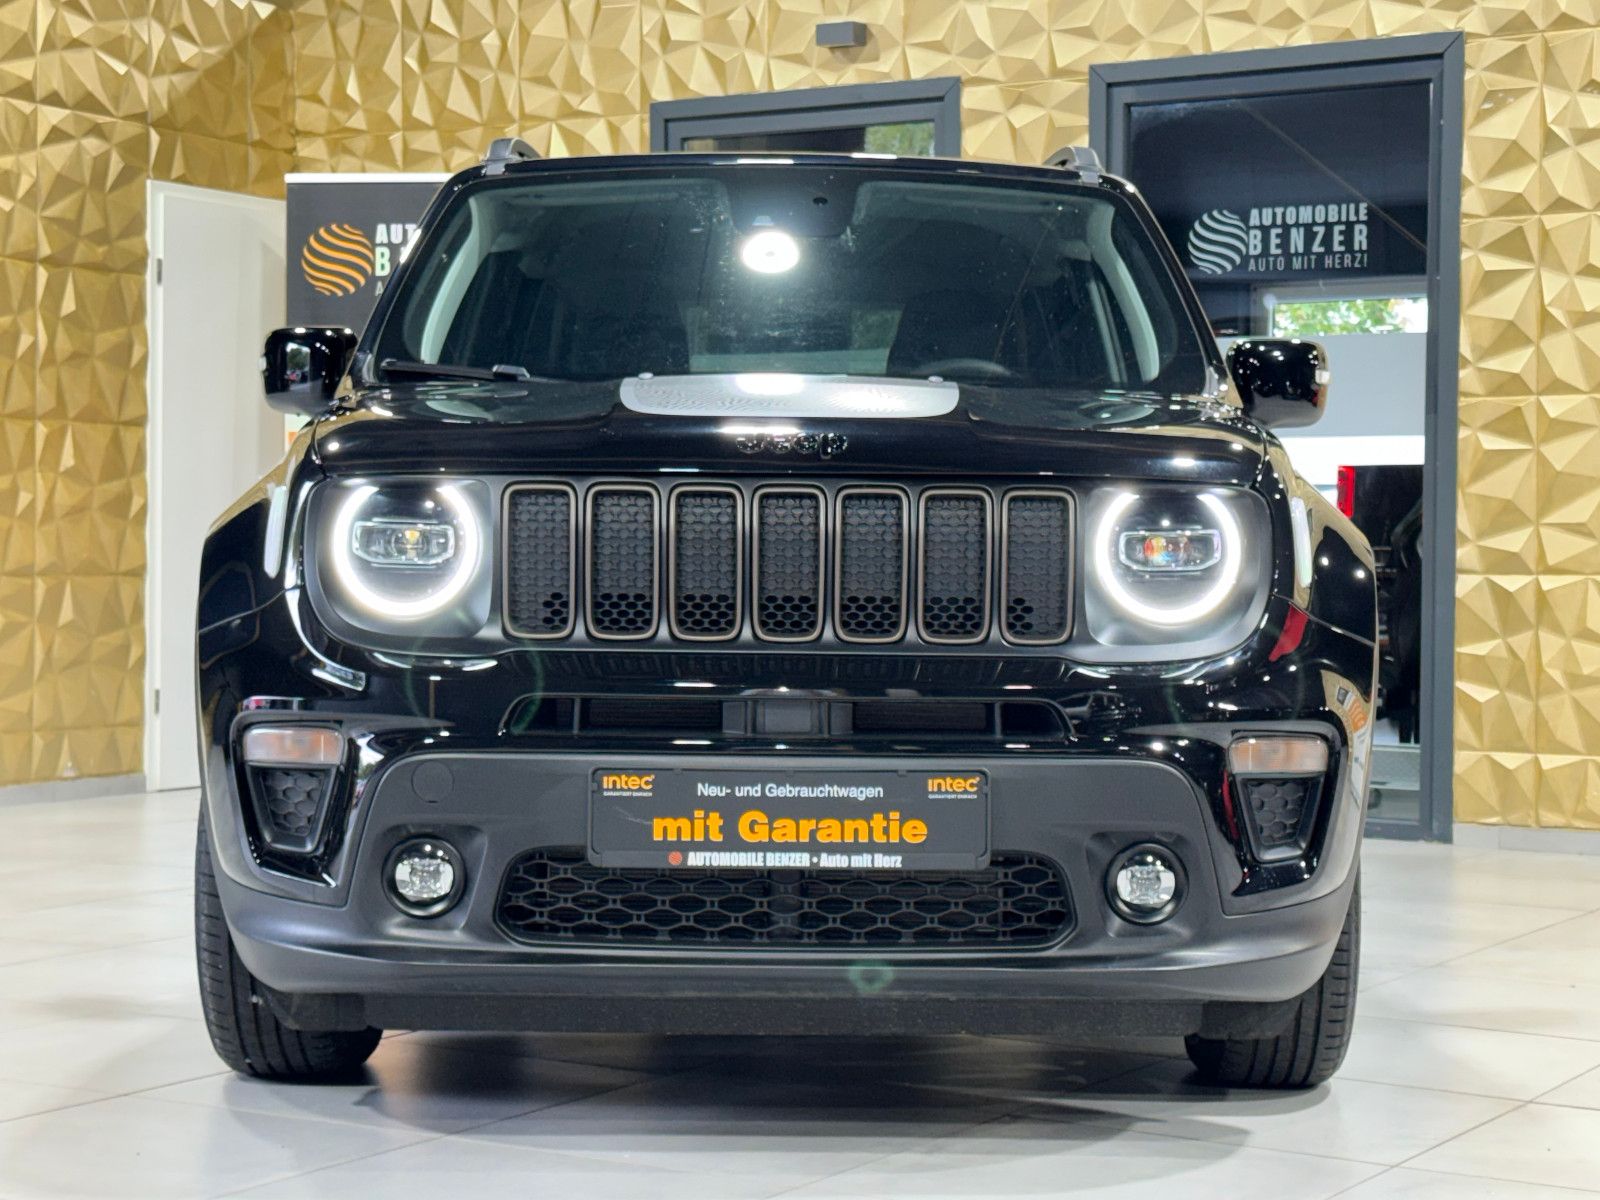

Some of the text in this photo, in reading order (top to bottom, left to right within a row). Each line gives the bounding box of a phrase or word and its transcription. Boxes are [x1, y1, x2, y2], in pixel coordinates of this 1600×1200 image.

[1249, 203, 1368, 226] AUTOMOBILE
[1249, 224, 1368, 256] BENZER
[1249, 257, 1285, 272] AUTO
[1292, 255, 1316, 270] MIT
[603, 774, 655, 790] intec
[927, 777, 980, 793] intec
[697, 783, 884, 801] Neu- und Gebrauchtwagen
[653, 810, 928, 843] mit Garantie
[687, 851, 902, 868] AUTOMOBILE BENZER Auto mit Herz
